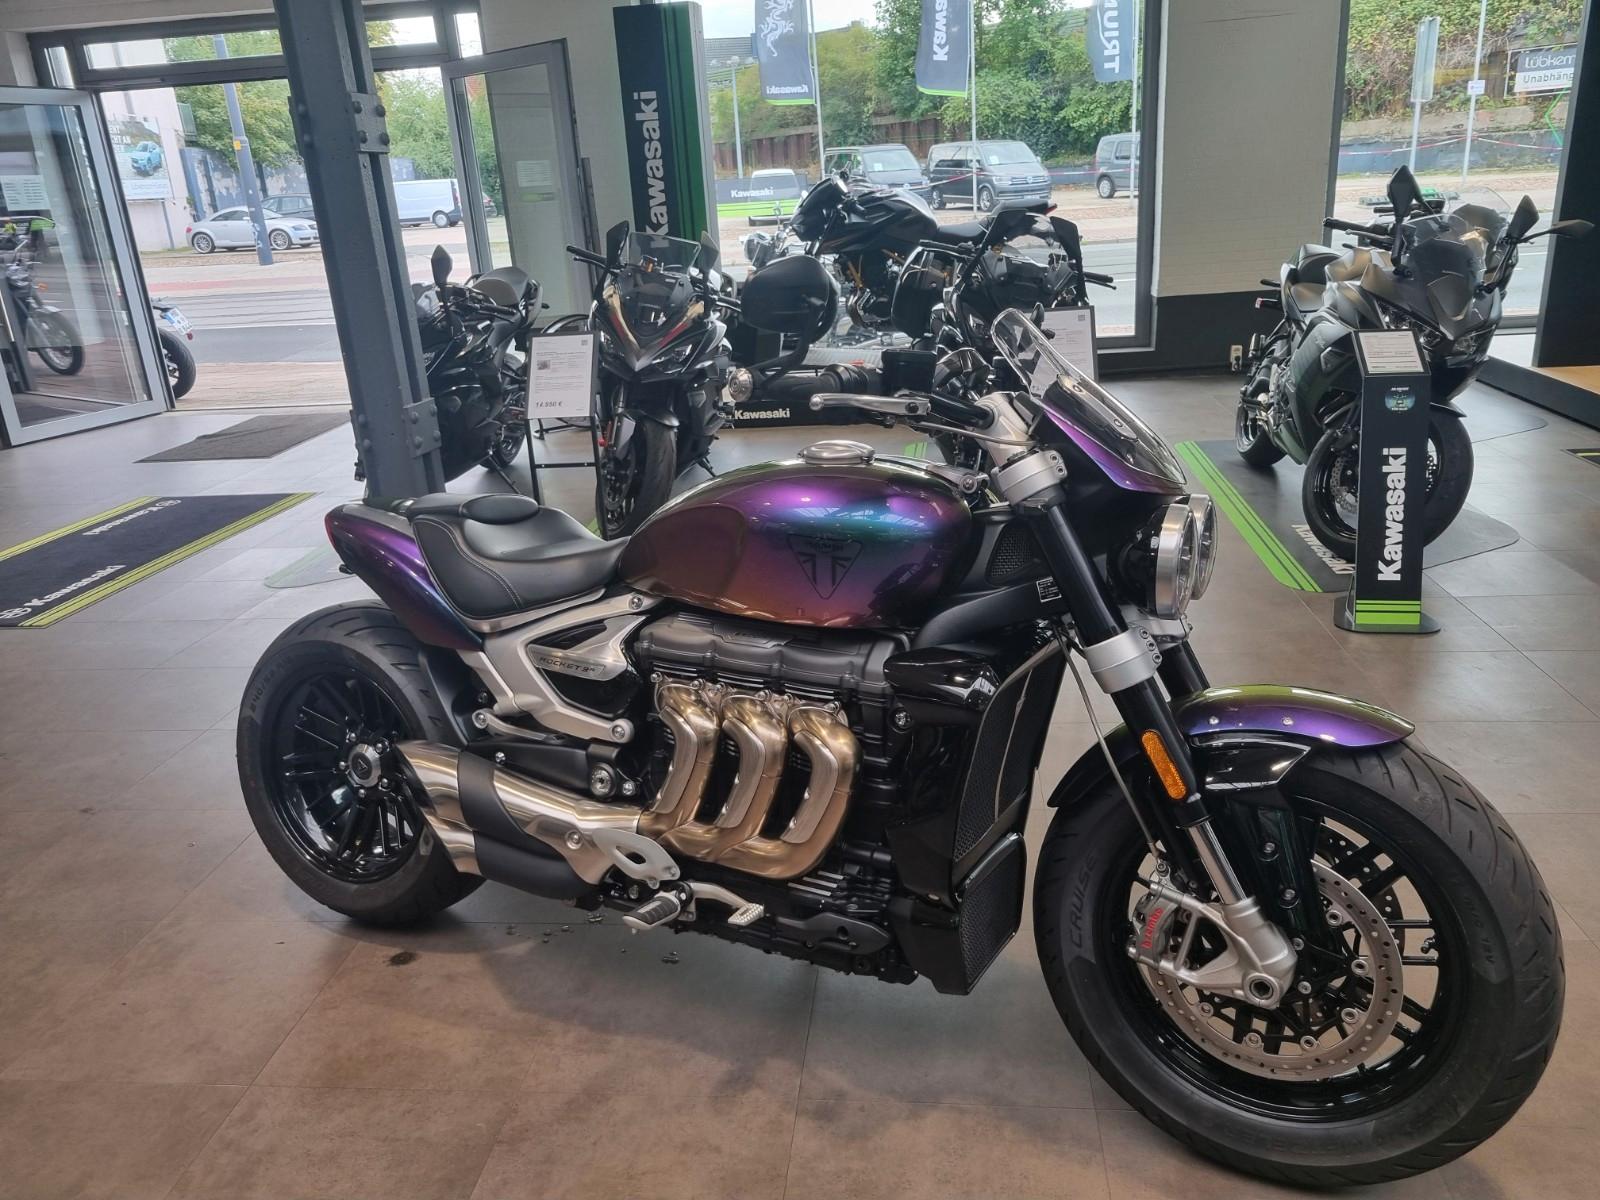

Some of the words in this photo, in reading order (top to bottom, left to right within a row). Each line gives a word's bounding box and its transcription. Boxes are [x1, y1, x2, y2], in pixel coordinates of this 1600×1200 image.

[633, 90, 670, 248] Kawasaki
[730, 186, 774, 198] Kawasaki
[734, 408, 791, 420] Kawasaki
[1377, 447, 1407, 581] Kawasaki
[1141, 907, 1164, 949] brembo
